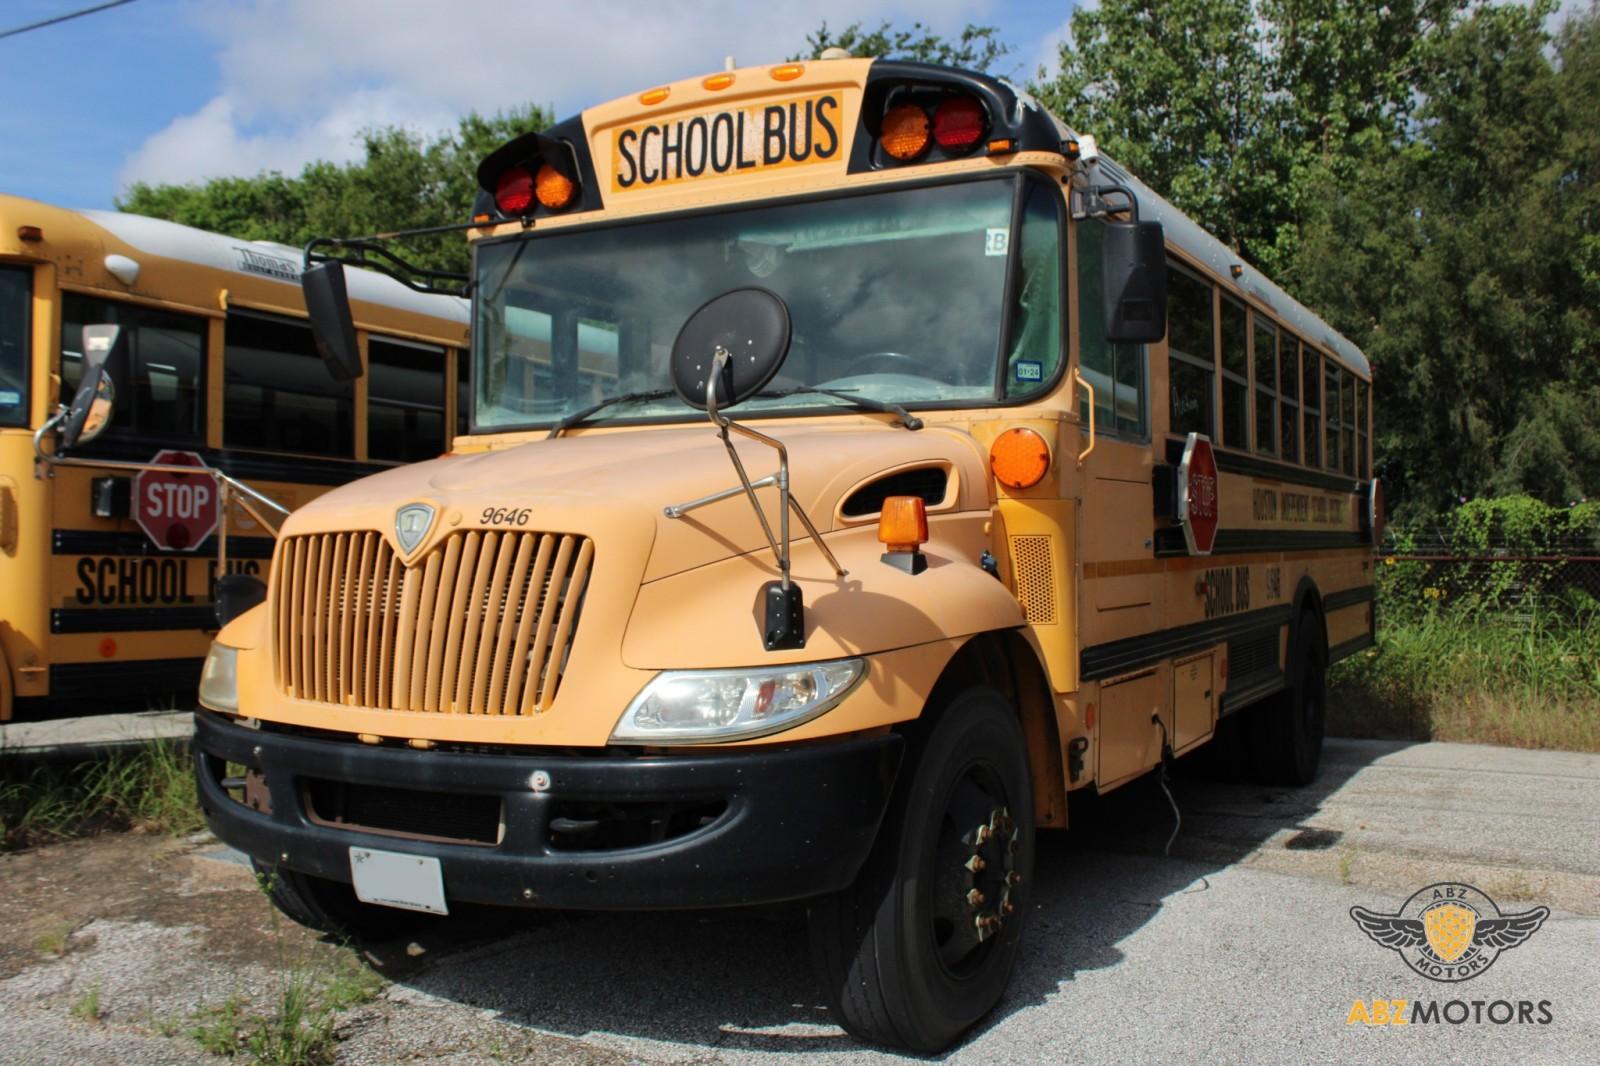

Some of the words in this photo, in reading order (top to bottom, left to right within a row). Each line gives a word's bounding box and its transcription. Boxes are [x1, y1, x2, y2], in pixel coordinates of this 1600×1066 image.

[617, 111, 756, 188] SCHOOL
[763, 96, 838, 166] BUS
[147, 482, 209, 519] STOP
[480, 507, 532, 526] 9646
[76, 557, 194, 605] SCHOOL
